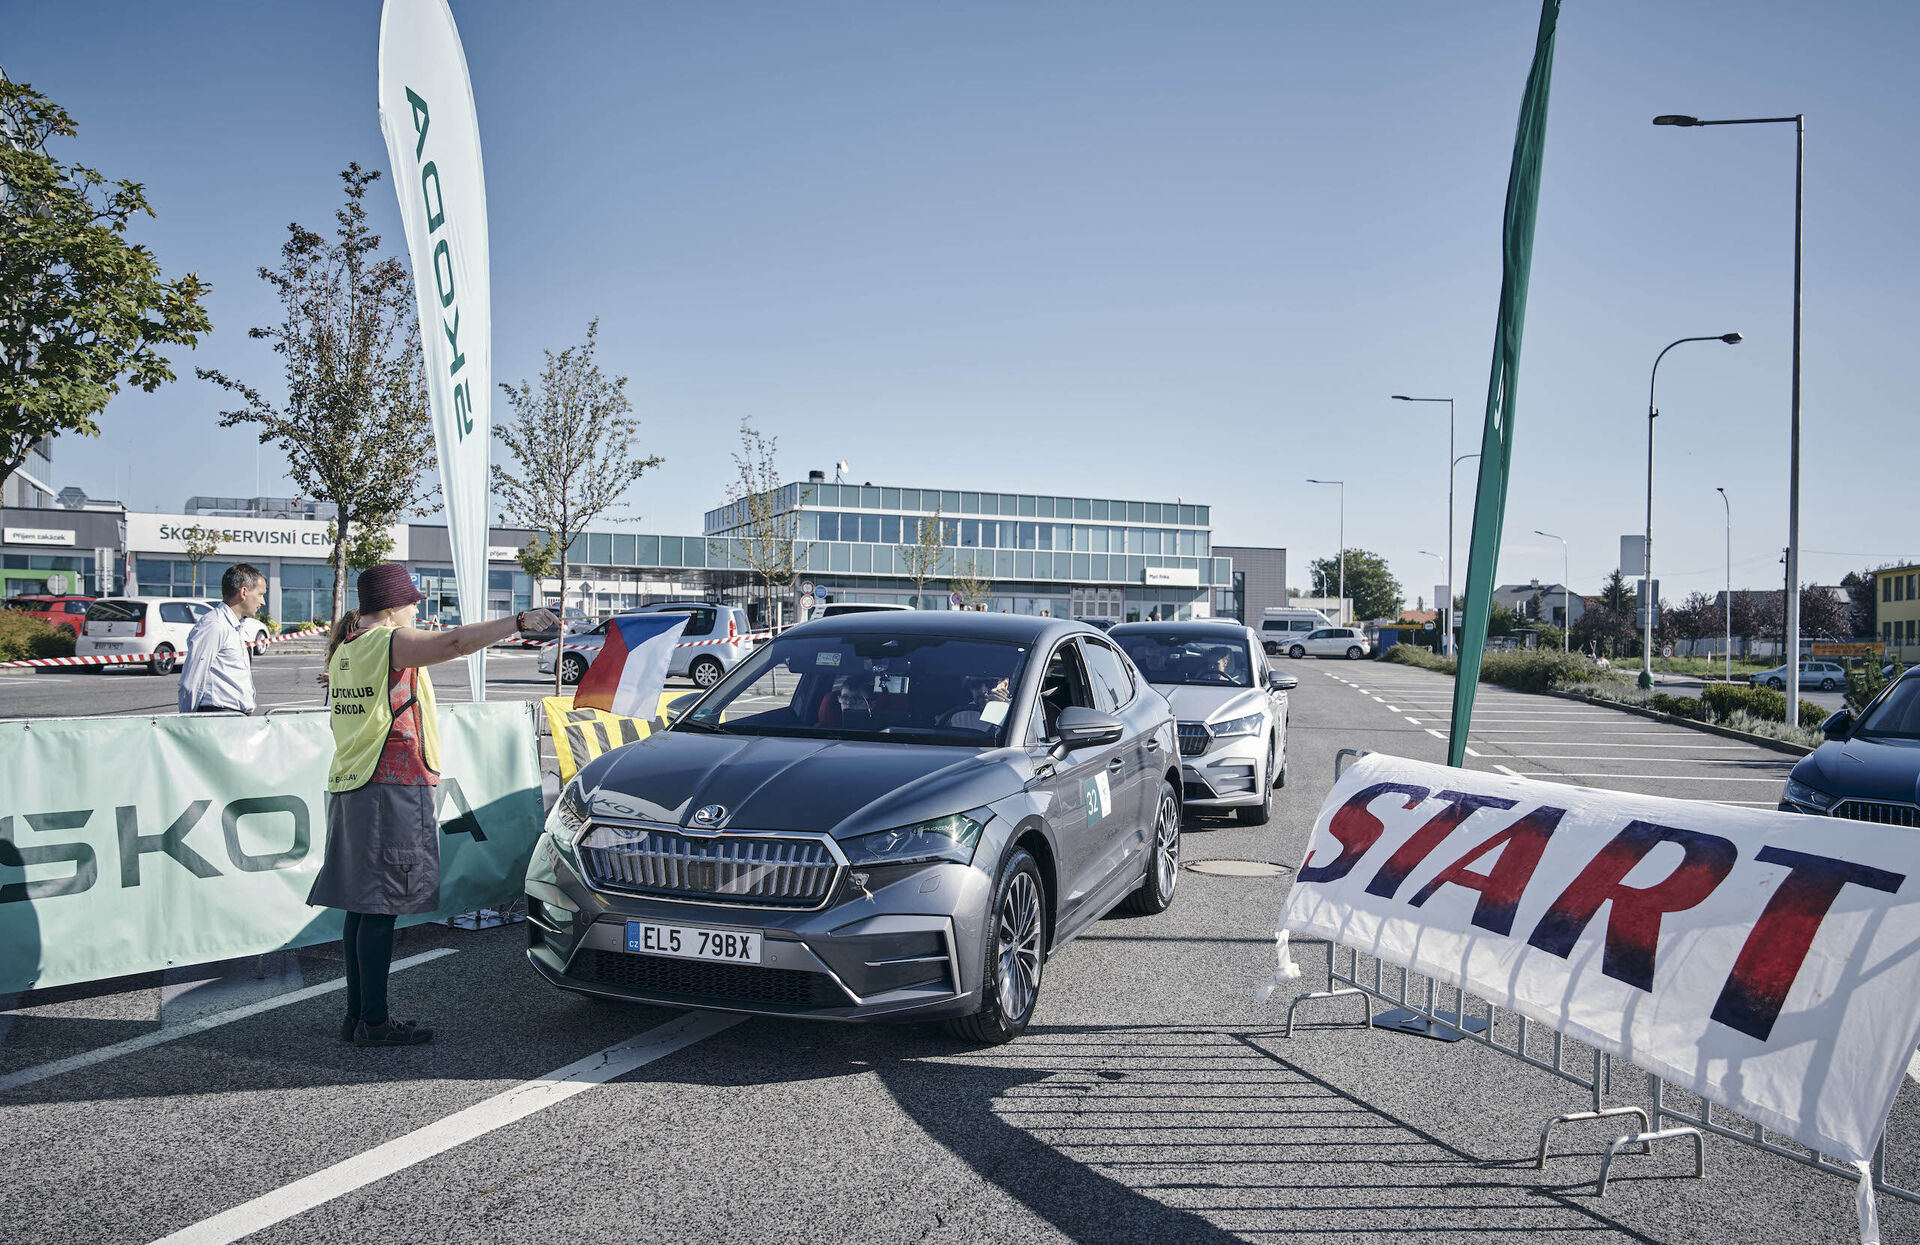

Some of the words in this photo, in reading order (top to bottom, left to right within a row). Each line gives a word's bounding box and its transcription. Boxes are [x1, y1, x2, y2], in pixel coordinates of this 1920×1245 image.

[159, 523, 216, 541] ŠKODA
[222, 528, 297, 545] SERVISNÍ
[331, 686, 375, 699] UTOKLUB
[334, 702, 366, 715] ŠKODA
[1086, 788, 1099, 816] 32
[0, 777, 488, 904] ŠKOA
[1295, 781, 1907, 1042] START
[629, 940, 639, 949] CZ
[643, 926, 682, 953] EL5
[698, 931, 751, 960] 79BX
